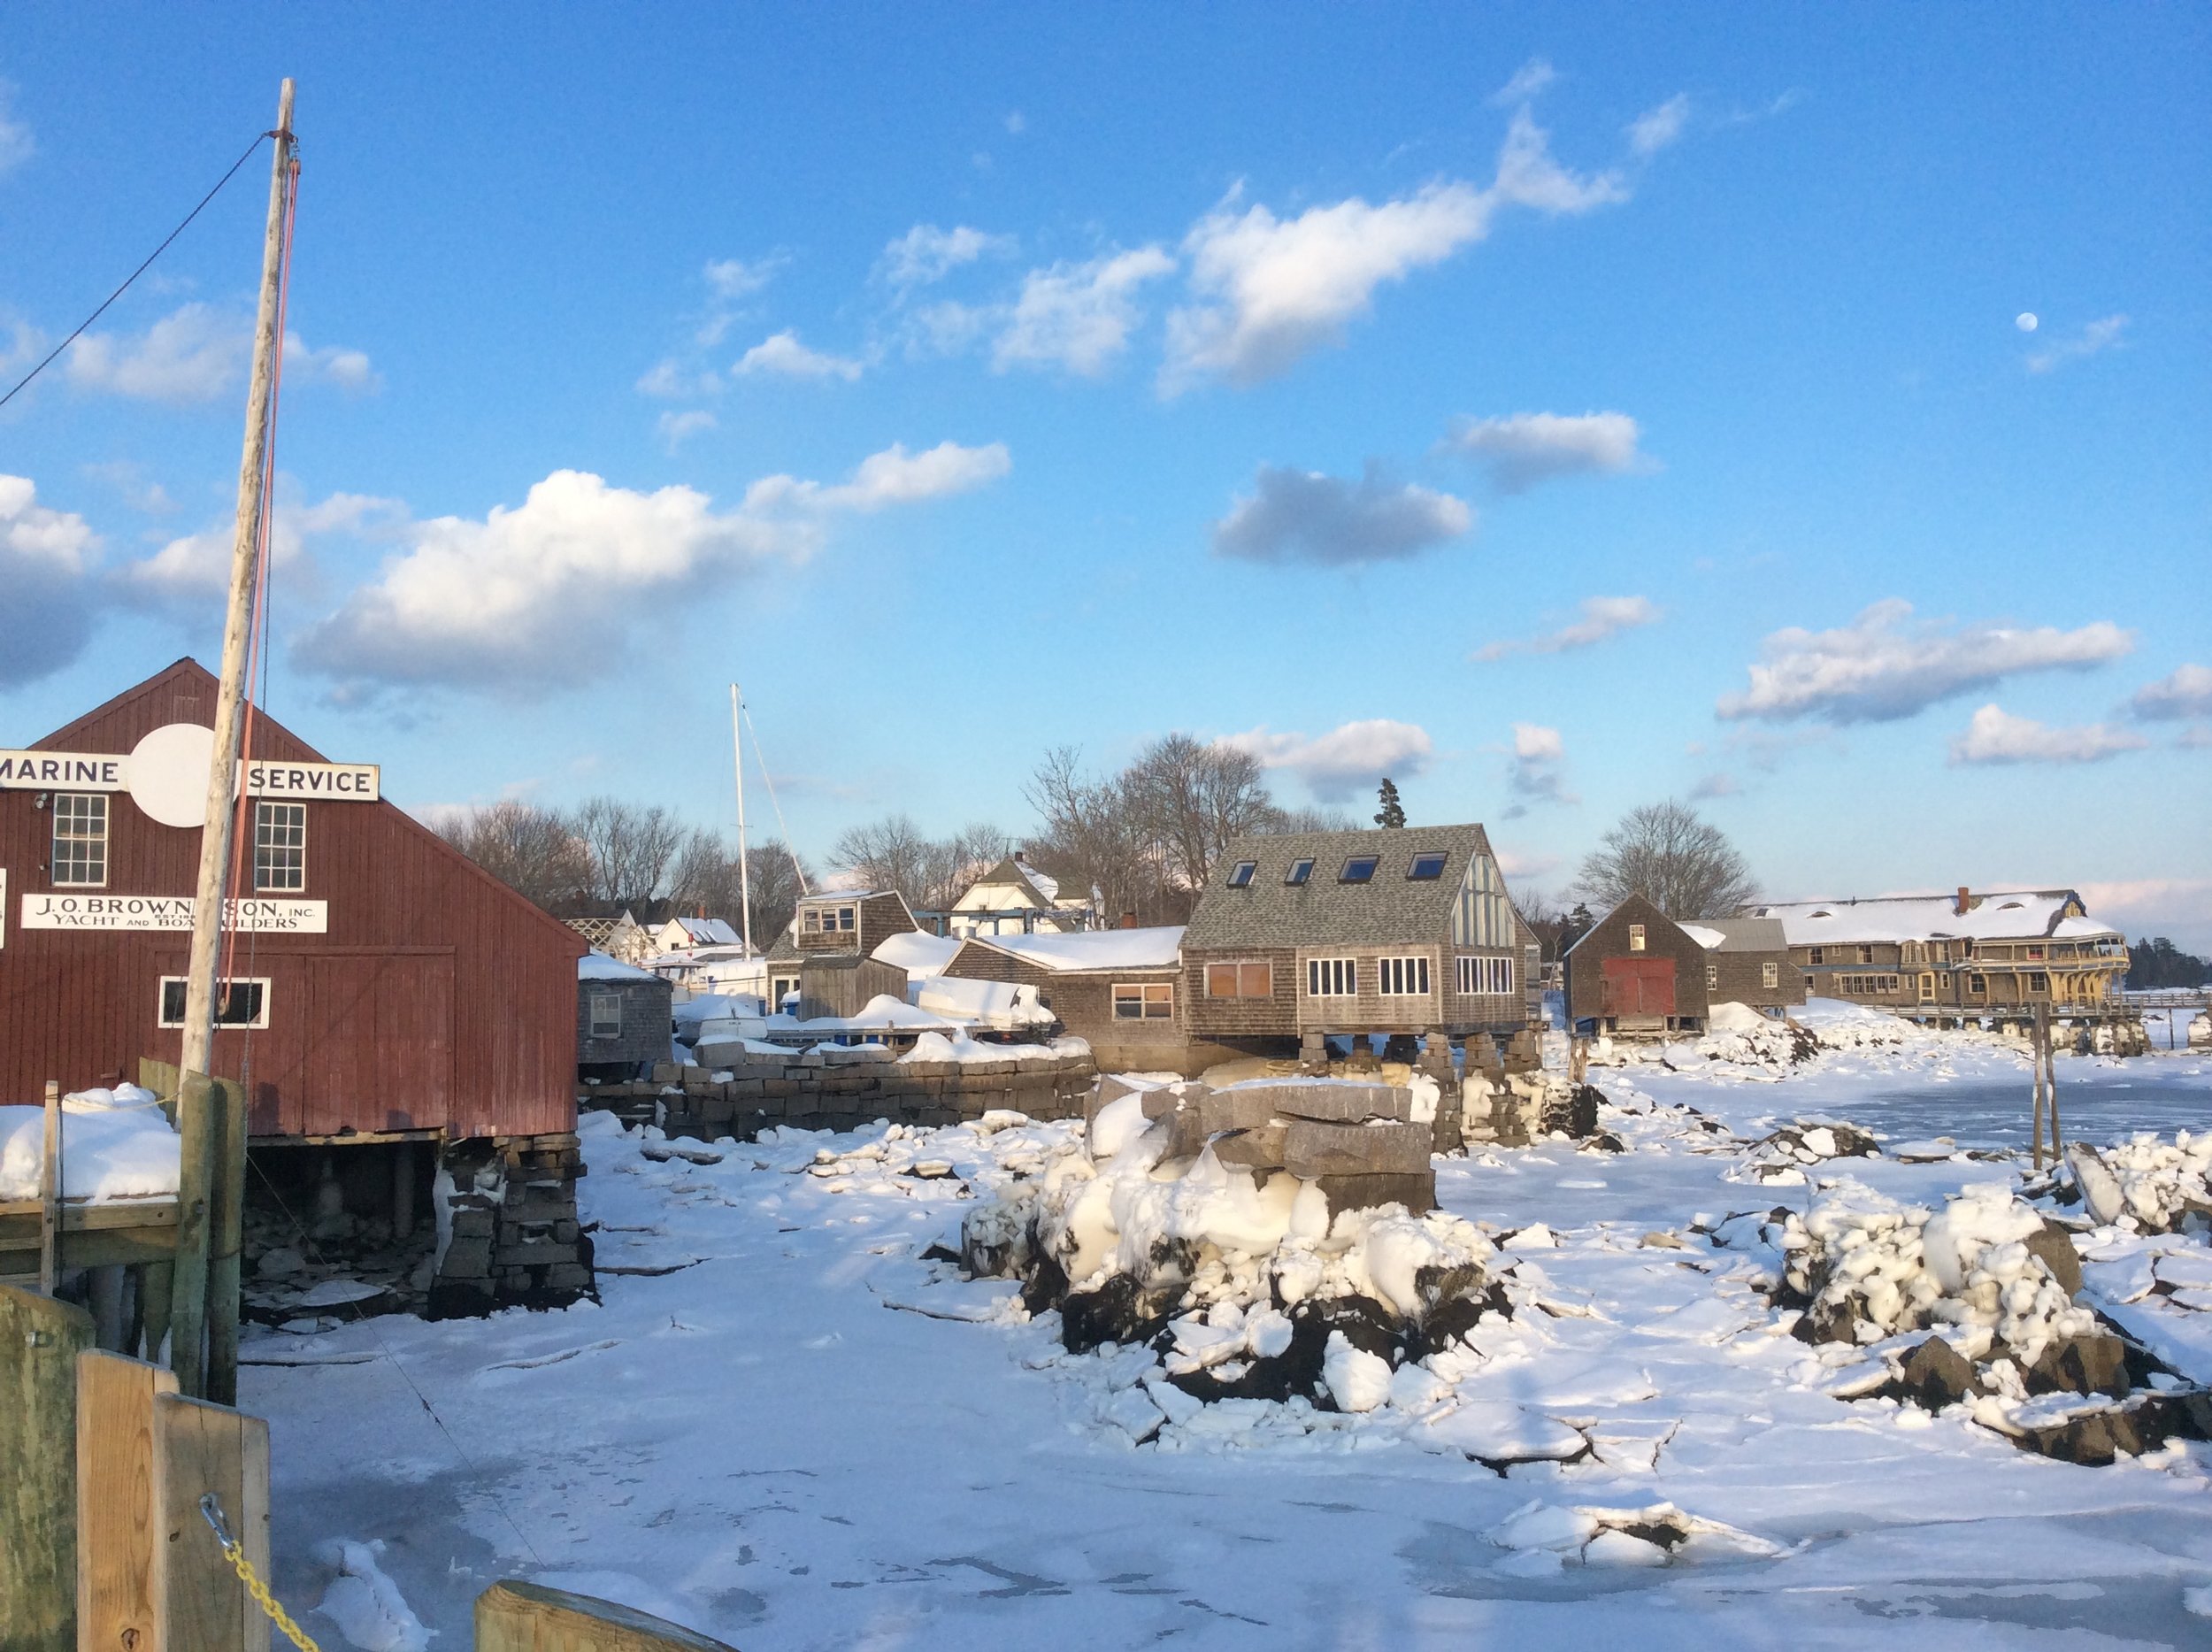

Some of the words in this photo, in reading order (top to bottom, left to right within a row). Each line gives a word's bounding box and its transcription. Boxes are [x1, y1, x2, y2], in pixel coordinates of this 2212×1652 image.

[249, 768, 371, 793] SERVICE
[88, 899, 191, 915] BROWN
[53, 914, 119, 926] YACHT
[158, 918, 196, 927] BOA
[222, 918, 297, 929] UILDERS
